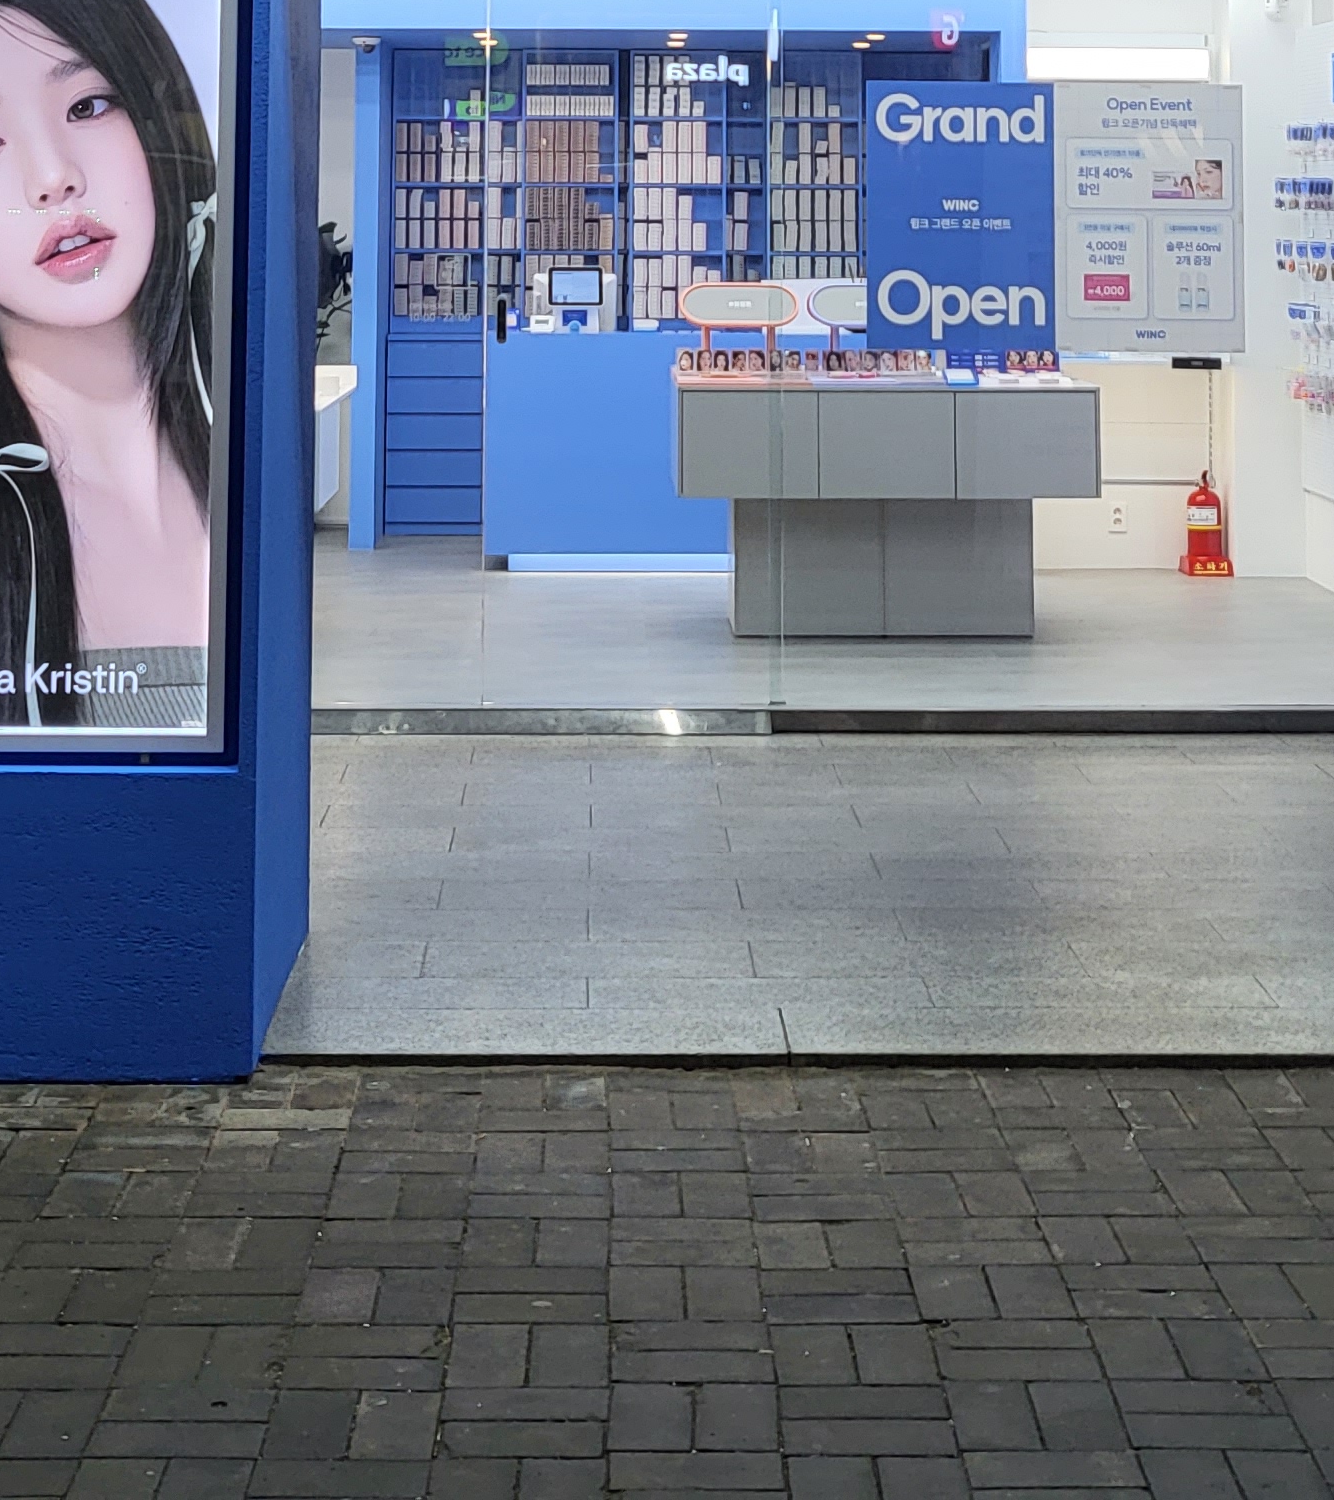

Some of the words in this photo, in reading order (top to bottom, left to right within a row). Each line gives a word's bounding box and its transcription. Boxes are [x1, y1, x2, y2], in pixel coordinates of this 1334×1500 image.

[1106, 97, 1148, 114] Open
[1150, 97, 1193, 112] Event
[875, 93, 1046, 144] Grand
[1077, 167, 1100, 180] 최대
[1102, 167, 1133, 180] 40%
[1078, 182, 1100, 196] 할인
[942, 199, 980, 212] WINC
[1085, 240, 1127, 253] 4,000원
[1195, 241, 1222, 252] 60ml
[877, 269, 1046, 340] Open
[1136, 329, 1167, 339] WINC
